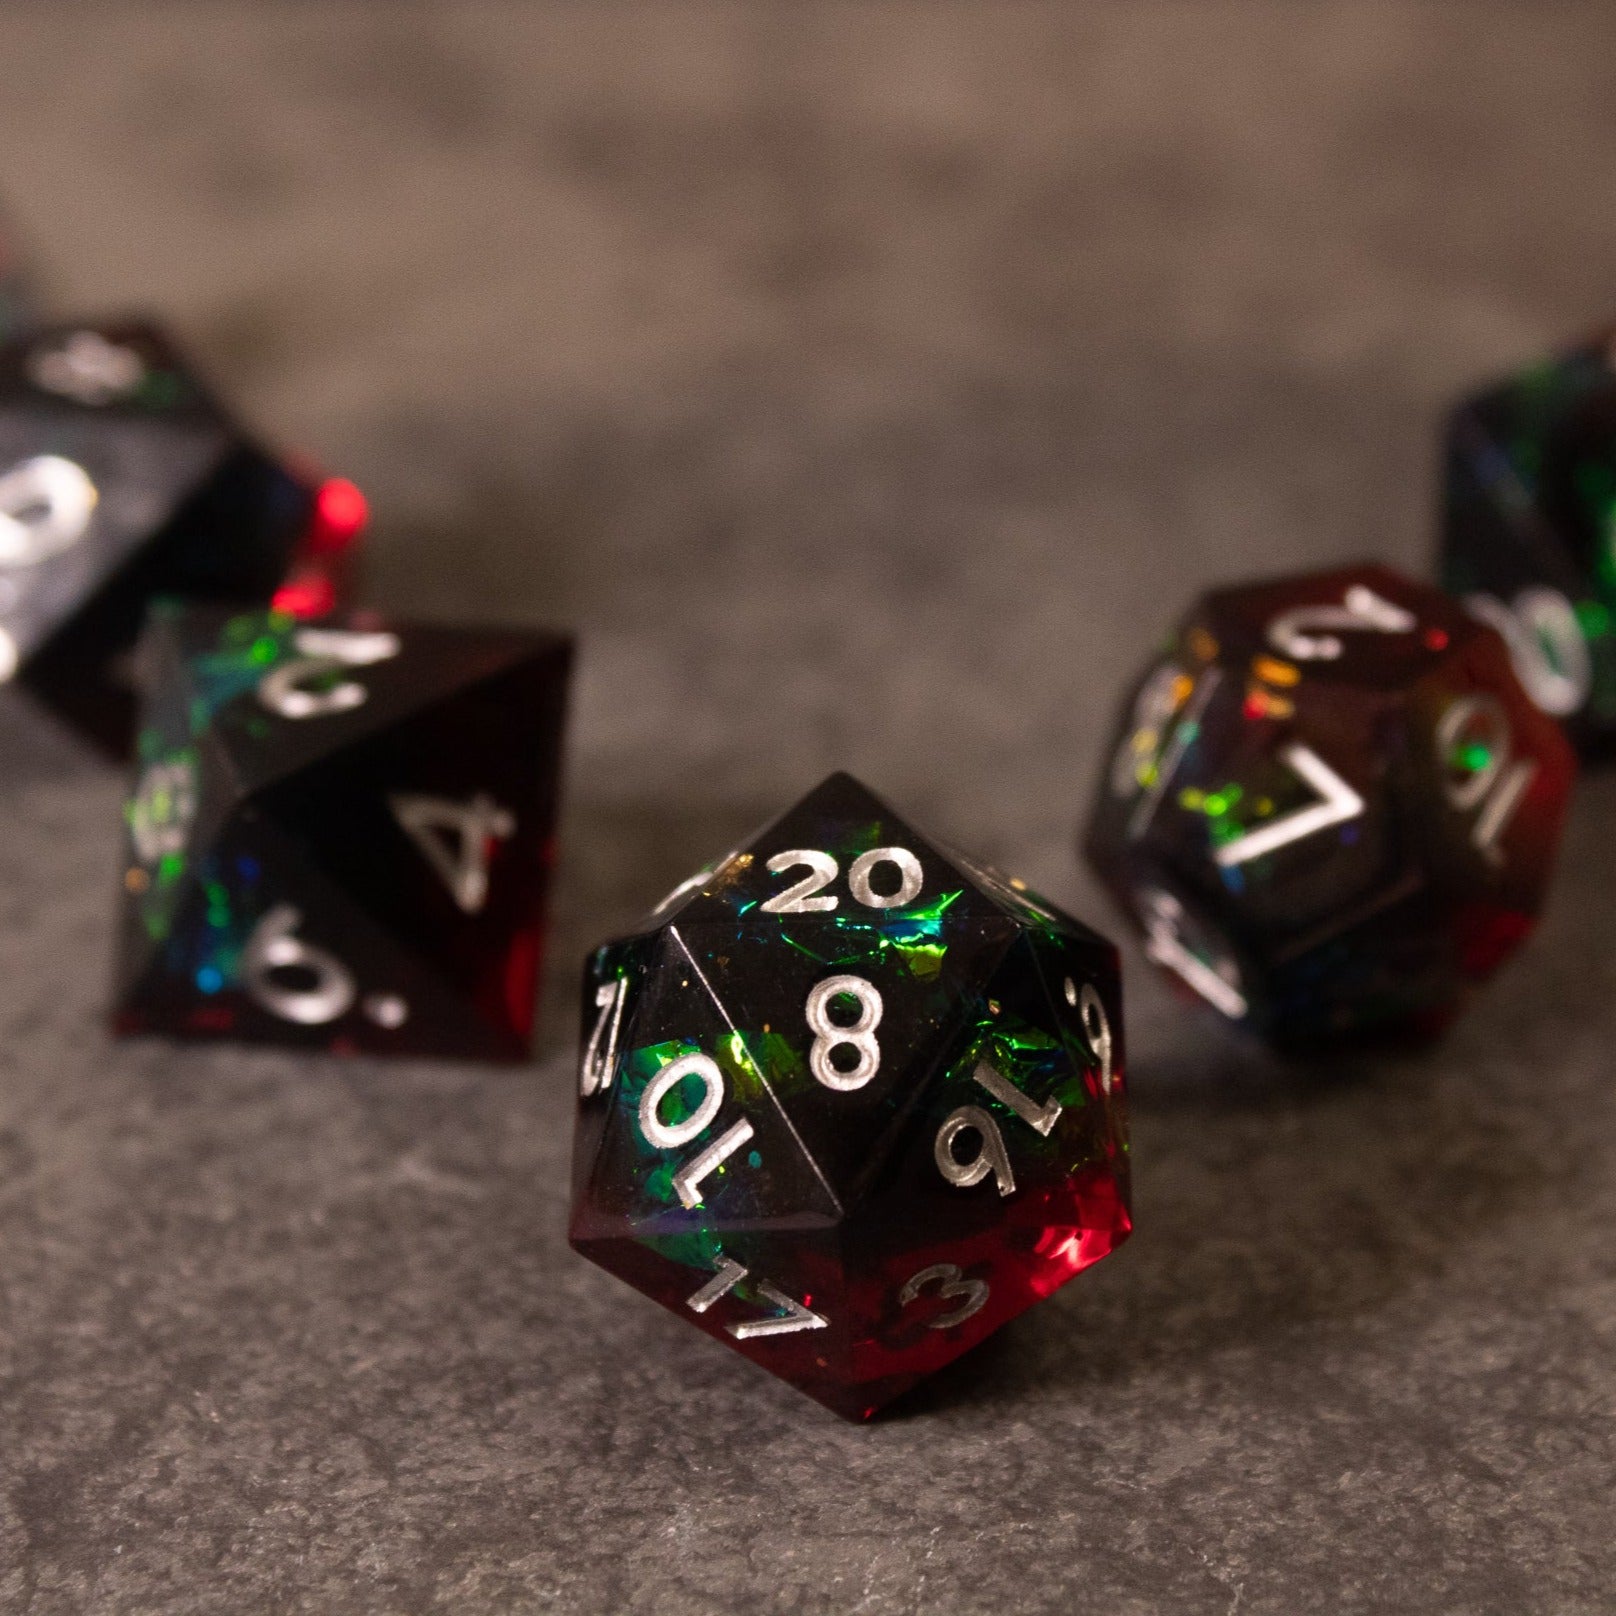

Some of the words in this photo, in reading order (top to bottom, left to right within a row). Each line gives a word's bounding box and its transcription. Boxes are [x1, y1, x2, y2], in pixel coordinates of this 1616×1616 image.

[392, 796, 518, 916] 4
[1214, 746, 1366, 866] 7
[760, 846, 924, 914] 20
[804, 974, 884, 1091] 8
[638, 1052, 755, 1209] 10
[933, 1058, 1063, 1197] 16
[686, 1256, 829, 1341] 17
[901, 1262, 991, 1330] 3
